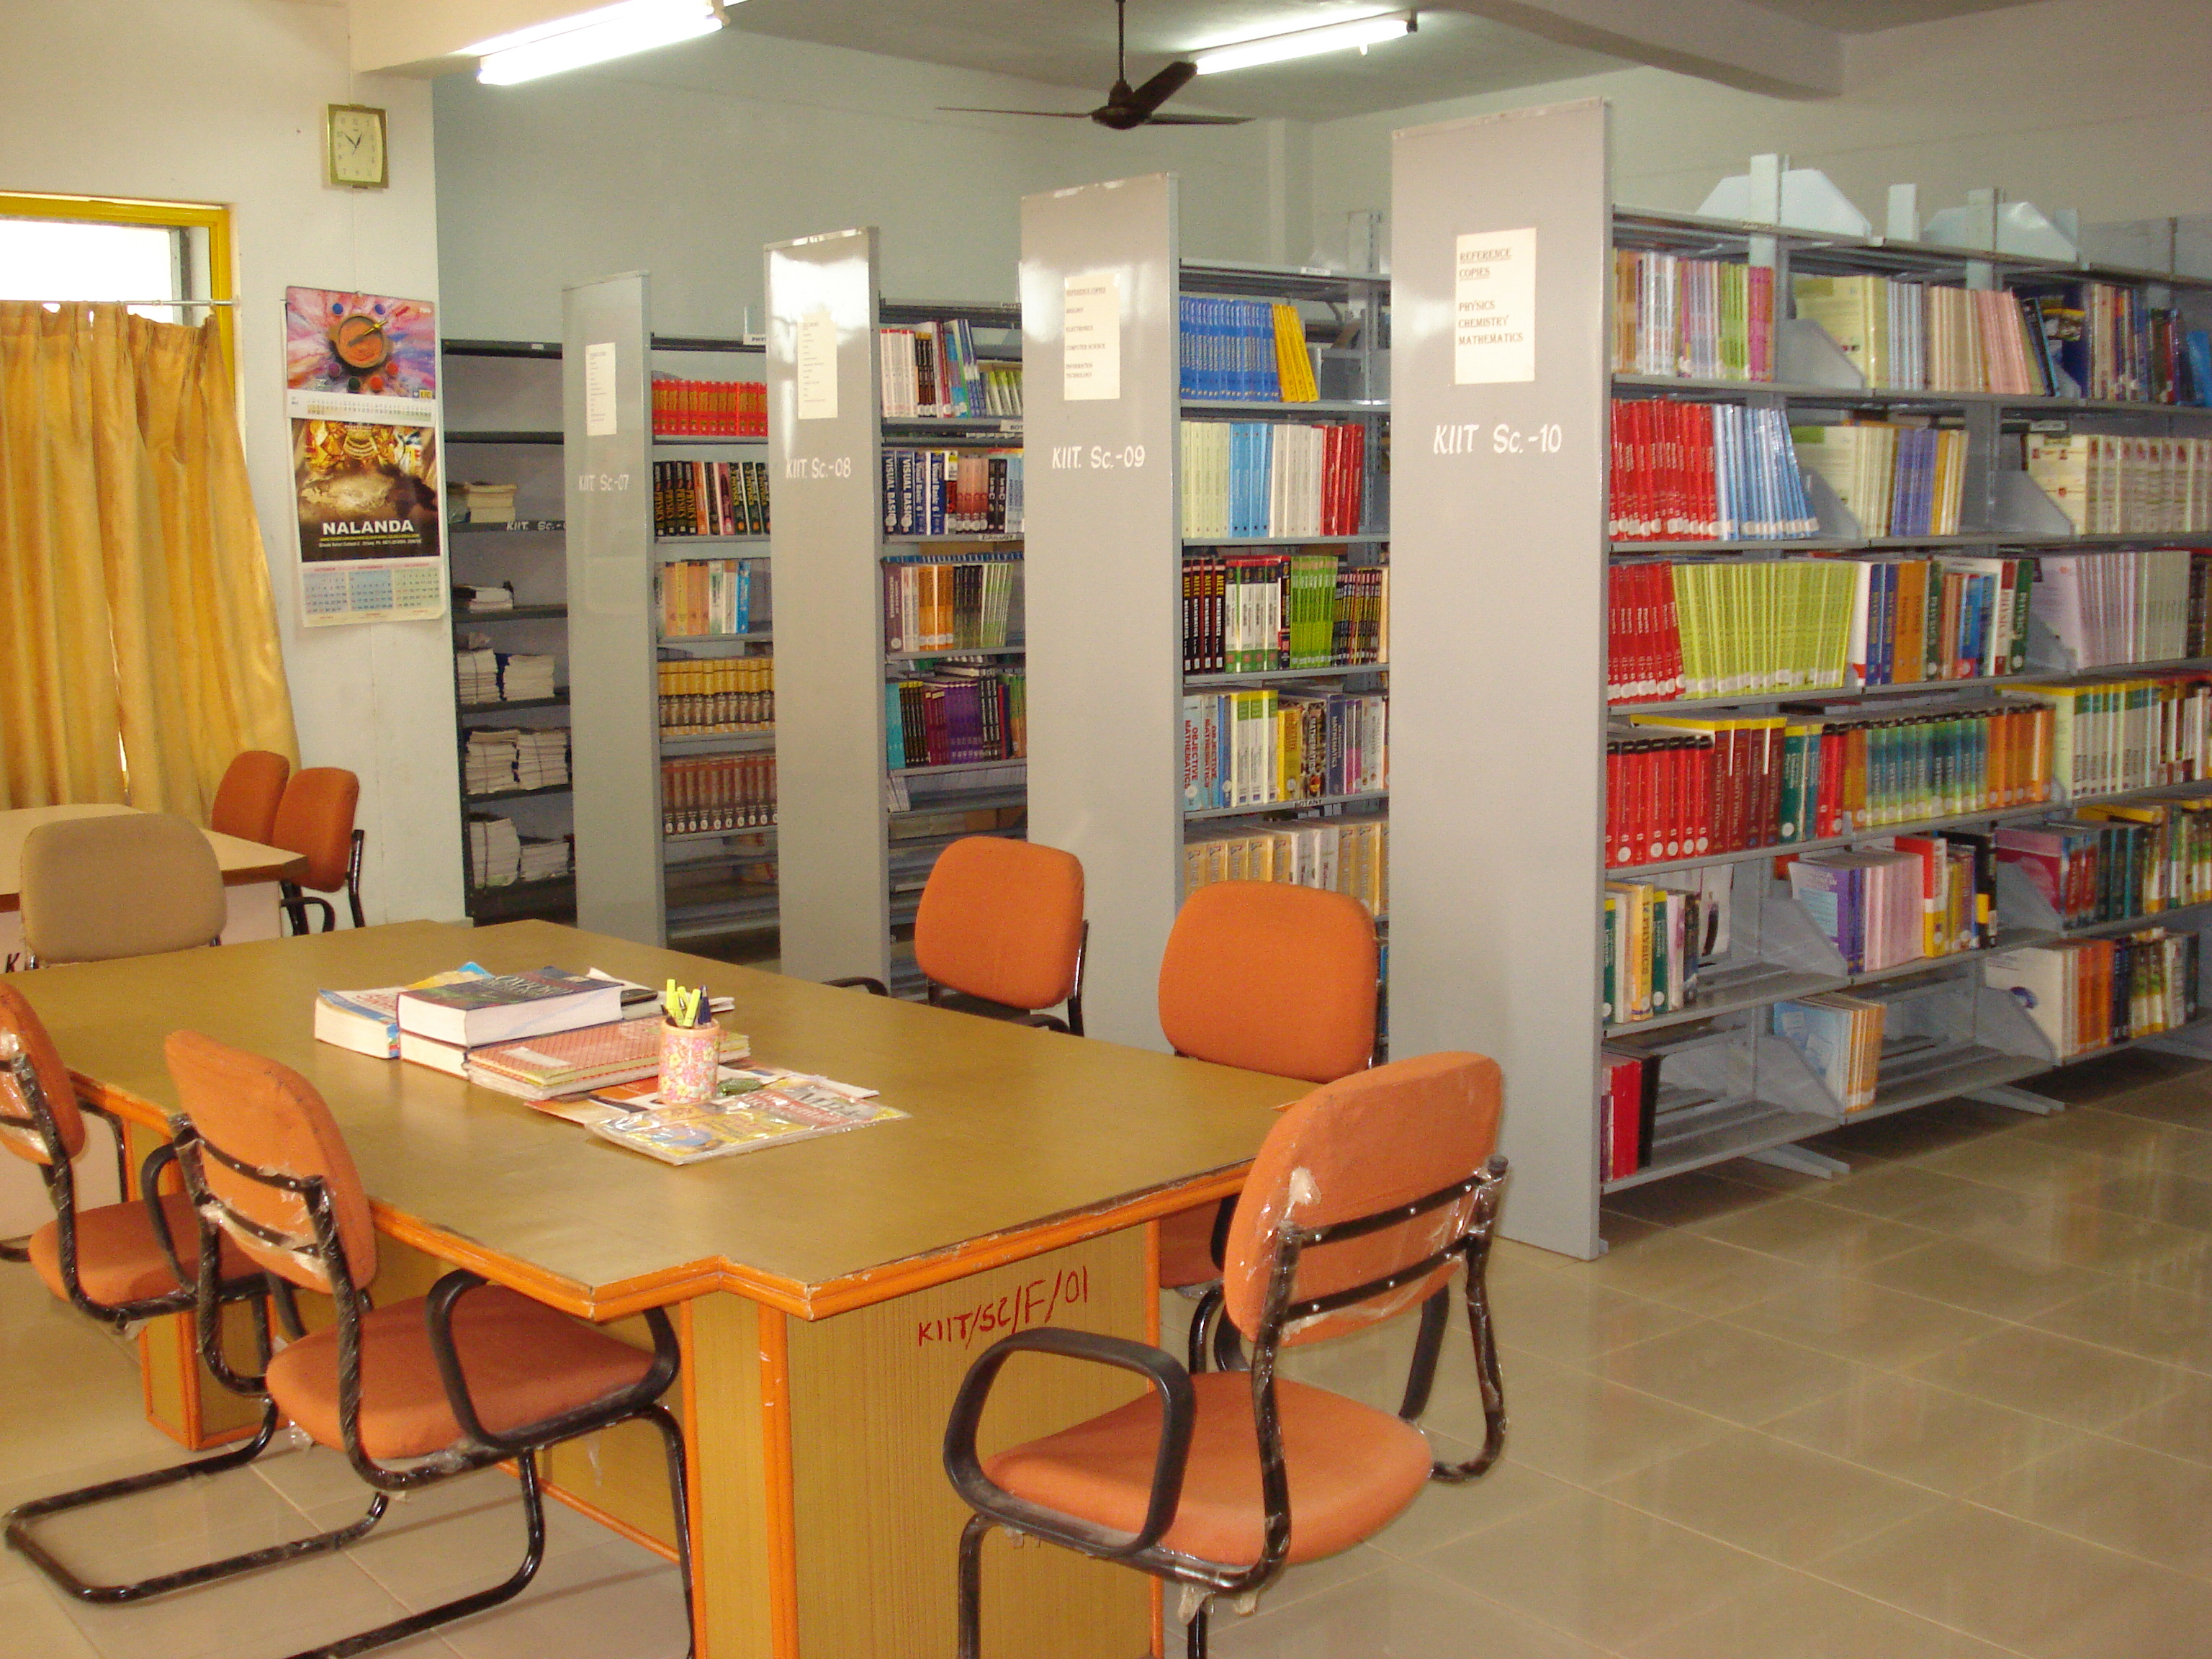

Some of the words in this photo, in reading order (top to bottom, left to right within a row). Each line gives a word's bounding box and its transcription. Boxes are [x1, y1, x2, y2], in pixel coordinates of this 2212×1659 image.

[1459, 248, 1511, 261] REFERENCE
[1459, 266, 1491, 278] COPIES
[1459, 299, 1496, 311] PHYSICS
[1458, 315, 1509, 328] CHEMISTRY
[1458, 333, 1524, 346] MATHEMATICS
[1434, 424, 1480, 454] KIIT
[885, 458, 894, 490] VISUAL
[902, 459, 912, 490] VISUAL
[323, 519, 414, 535] NALANDA
[1215, 575, 1224, 596] AIEEE
[919, 1266, 1088, 1350] KIIT/SC/F/01
